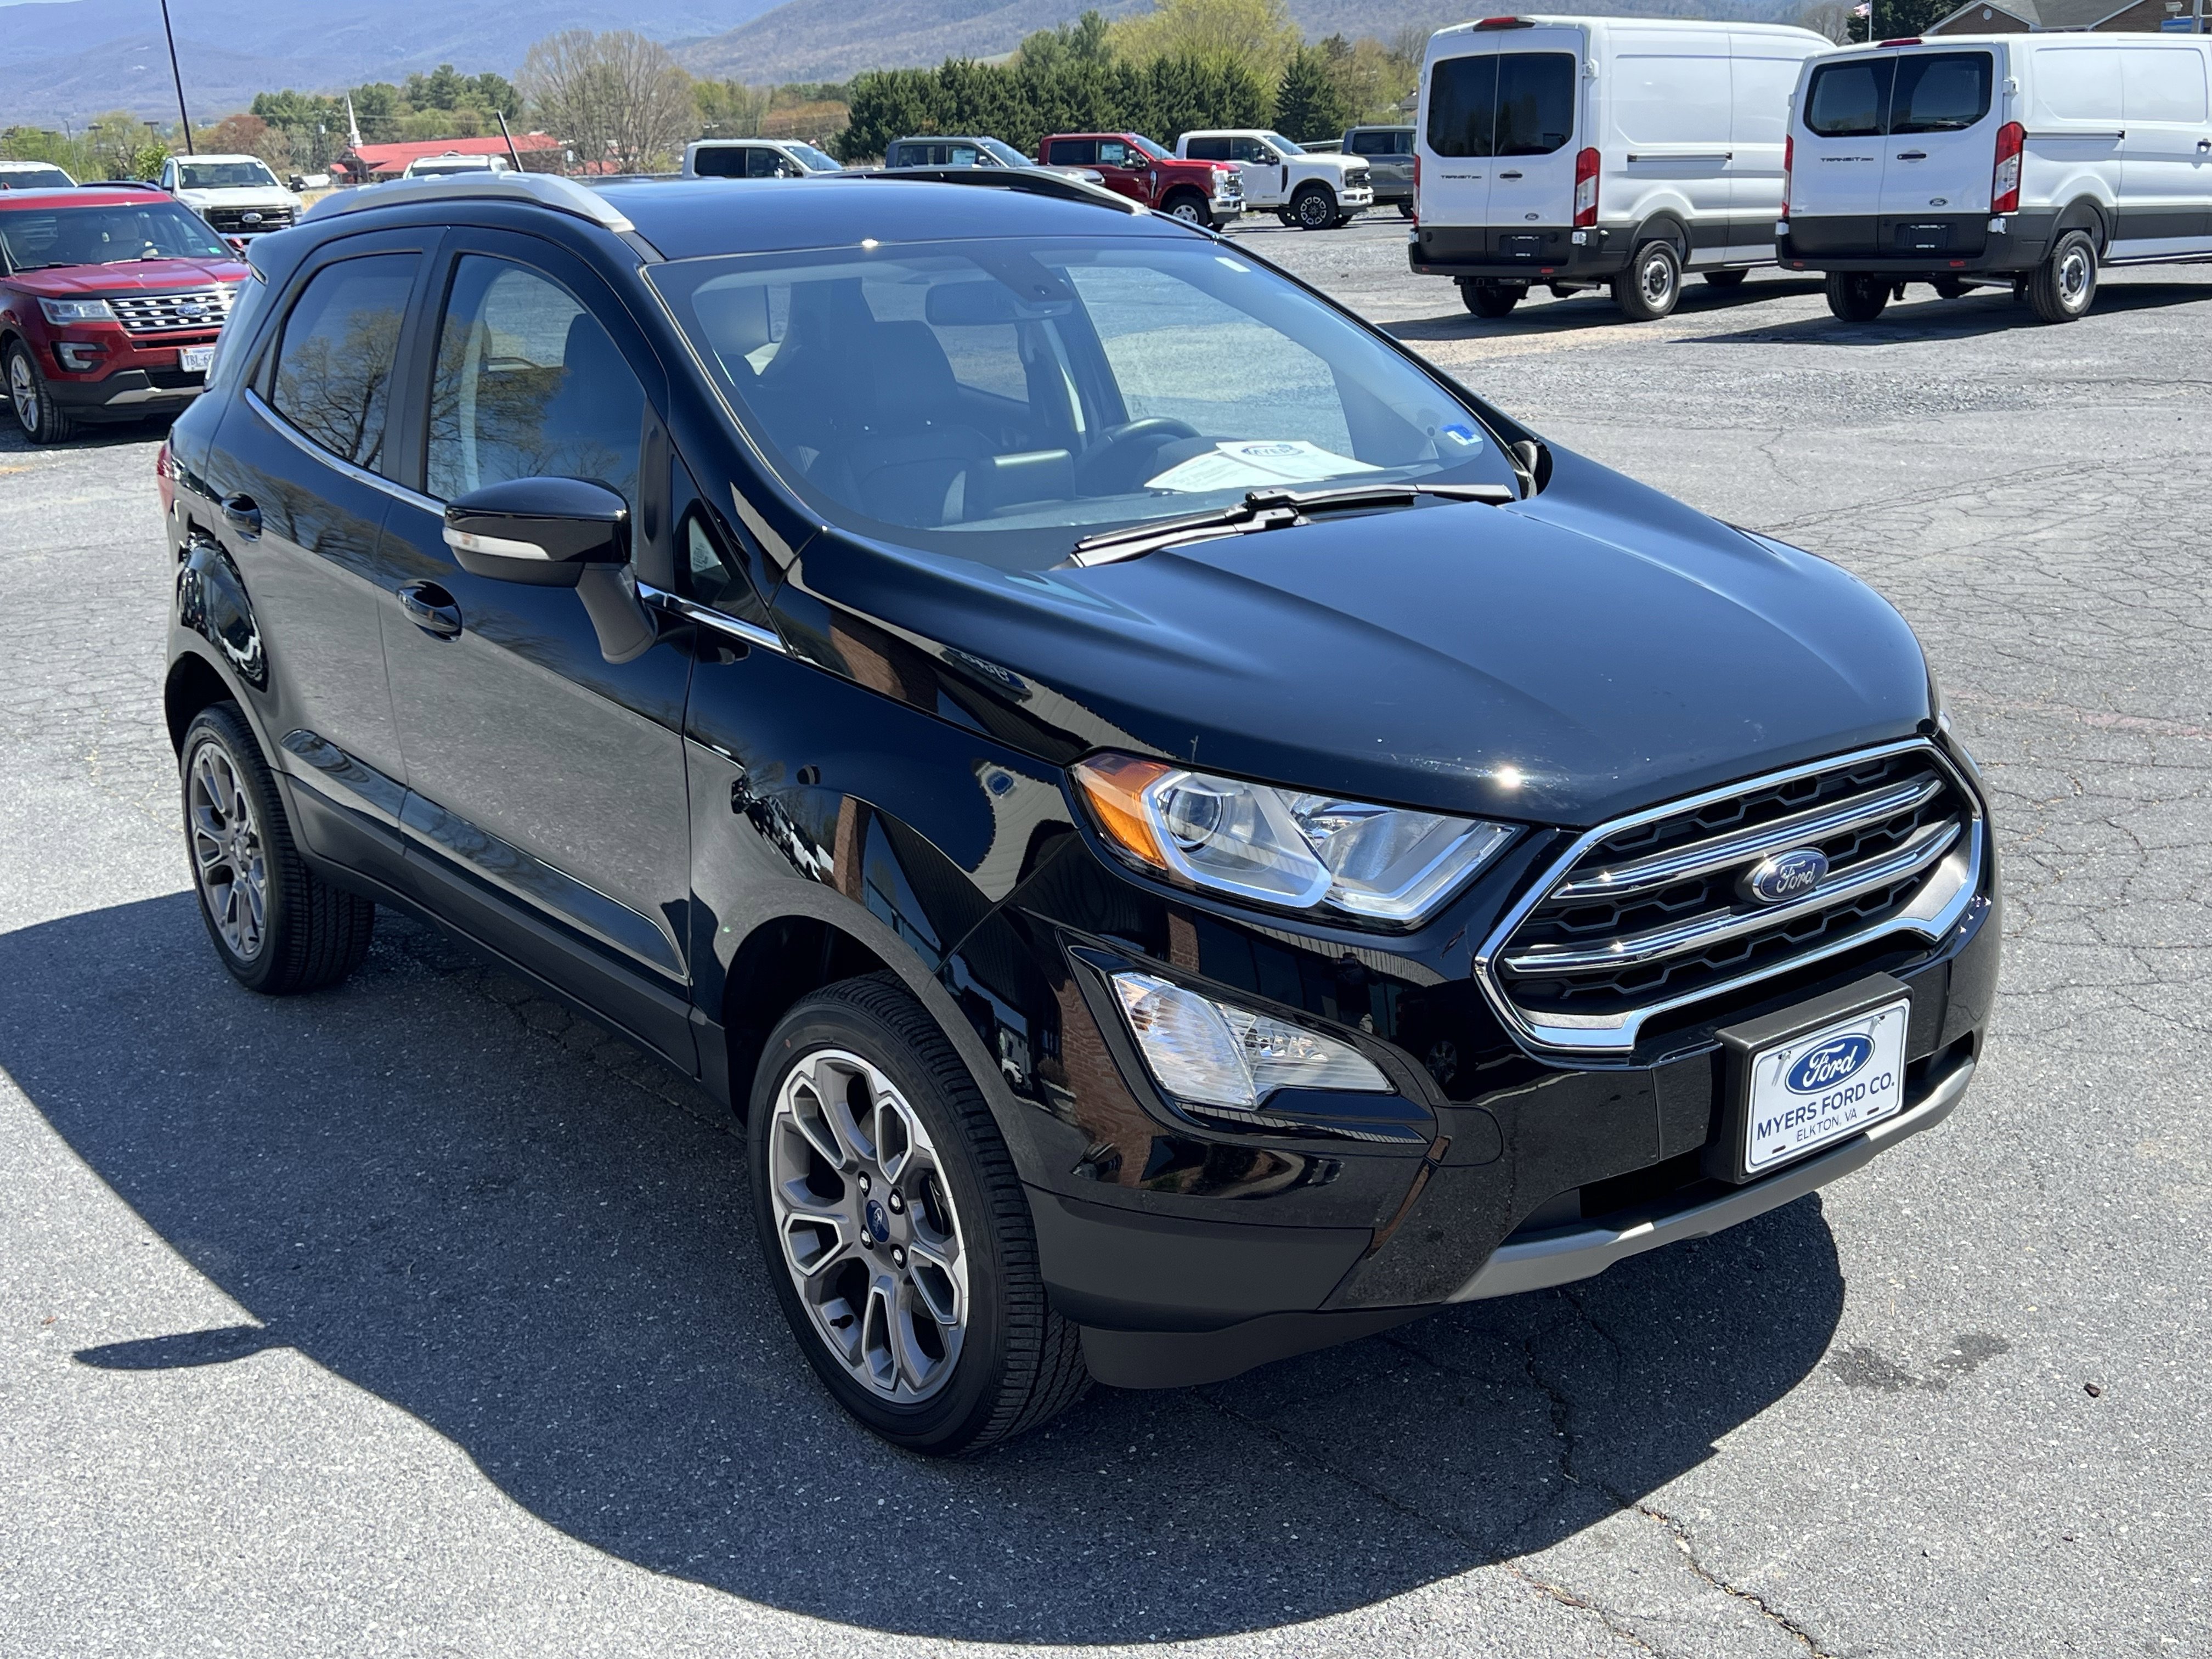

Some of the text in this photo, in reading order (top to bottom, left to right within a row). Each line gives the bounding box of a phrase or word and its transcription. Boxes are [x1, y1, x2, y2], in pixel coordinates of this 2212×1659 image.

[1776, 860, 1816, 893] Ford
[1803, 1043, 1859, 1088] Ford
[1757, 1072, 1895, 1141] MYERS FORD CO.
[1797, 1108, 1858, 1142] ELKTON, VA
